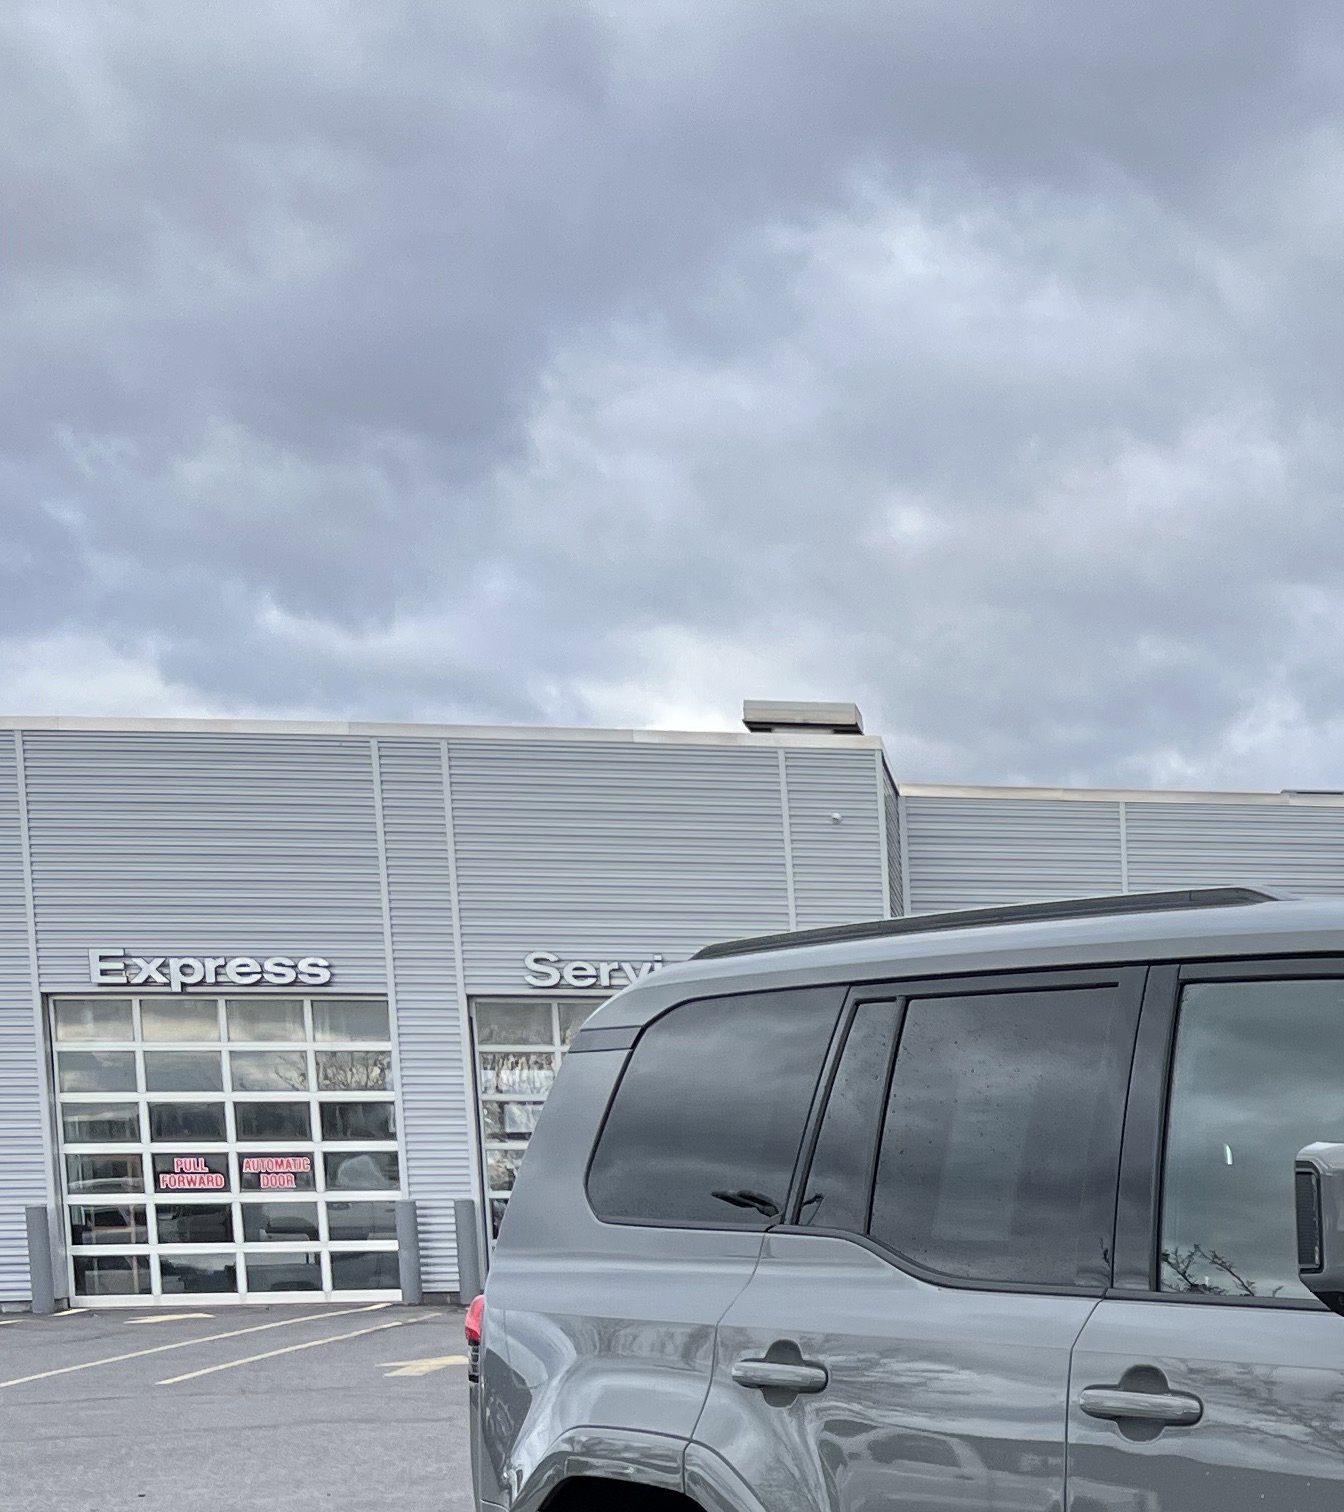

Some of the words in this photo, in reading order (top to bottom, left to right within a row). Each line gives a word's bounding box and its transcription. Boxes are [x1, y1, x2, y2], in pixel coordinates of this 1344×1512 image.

[88, 948, 332, 992] Express
[524, 951, 664, 987] Servi
[174, 1158, 208, 1172] PULL
[243, 1157, 311, 1172] AUTOMATIC
[160, 1174, 225, 1188] FORWARD
[260, 1174, 296, 1188] DOOR
